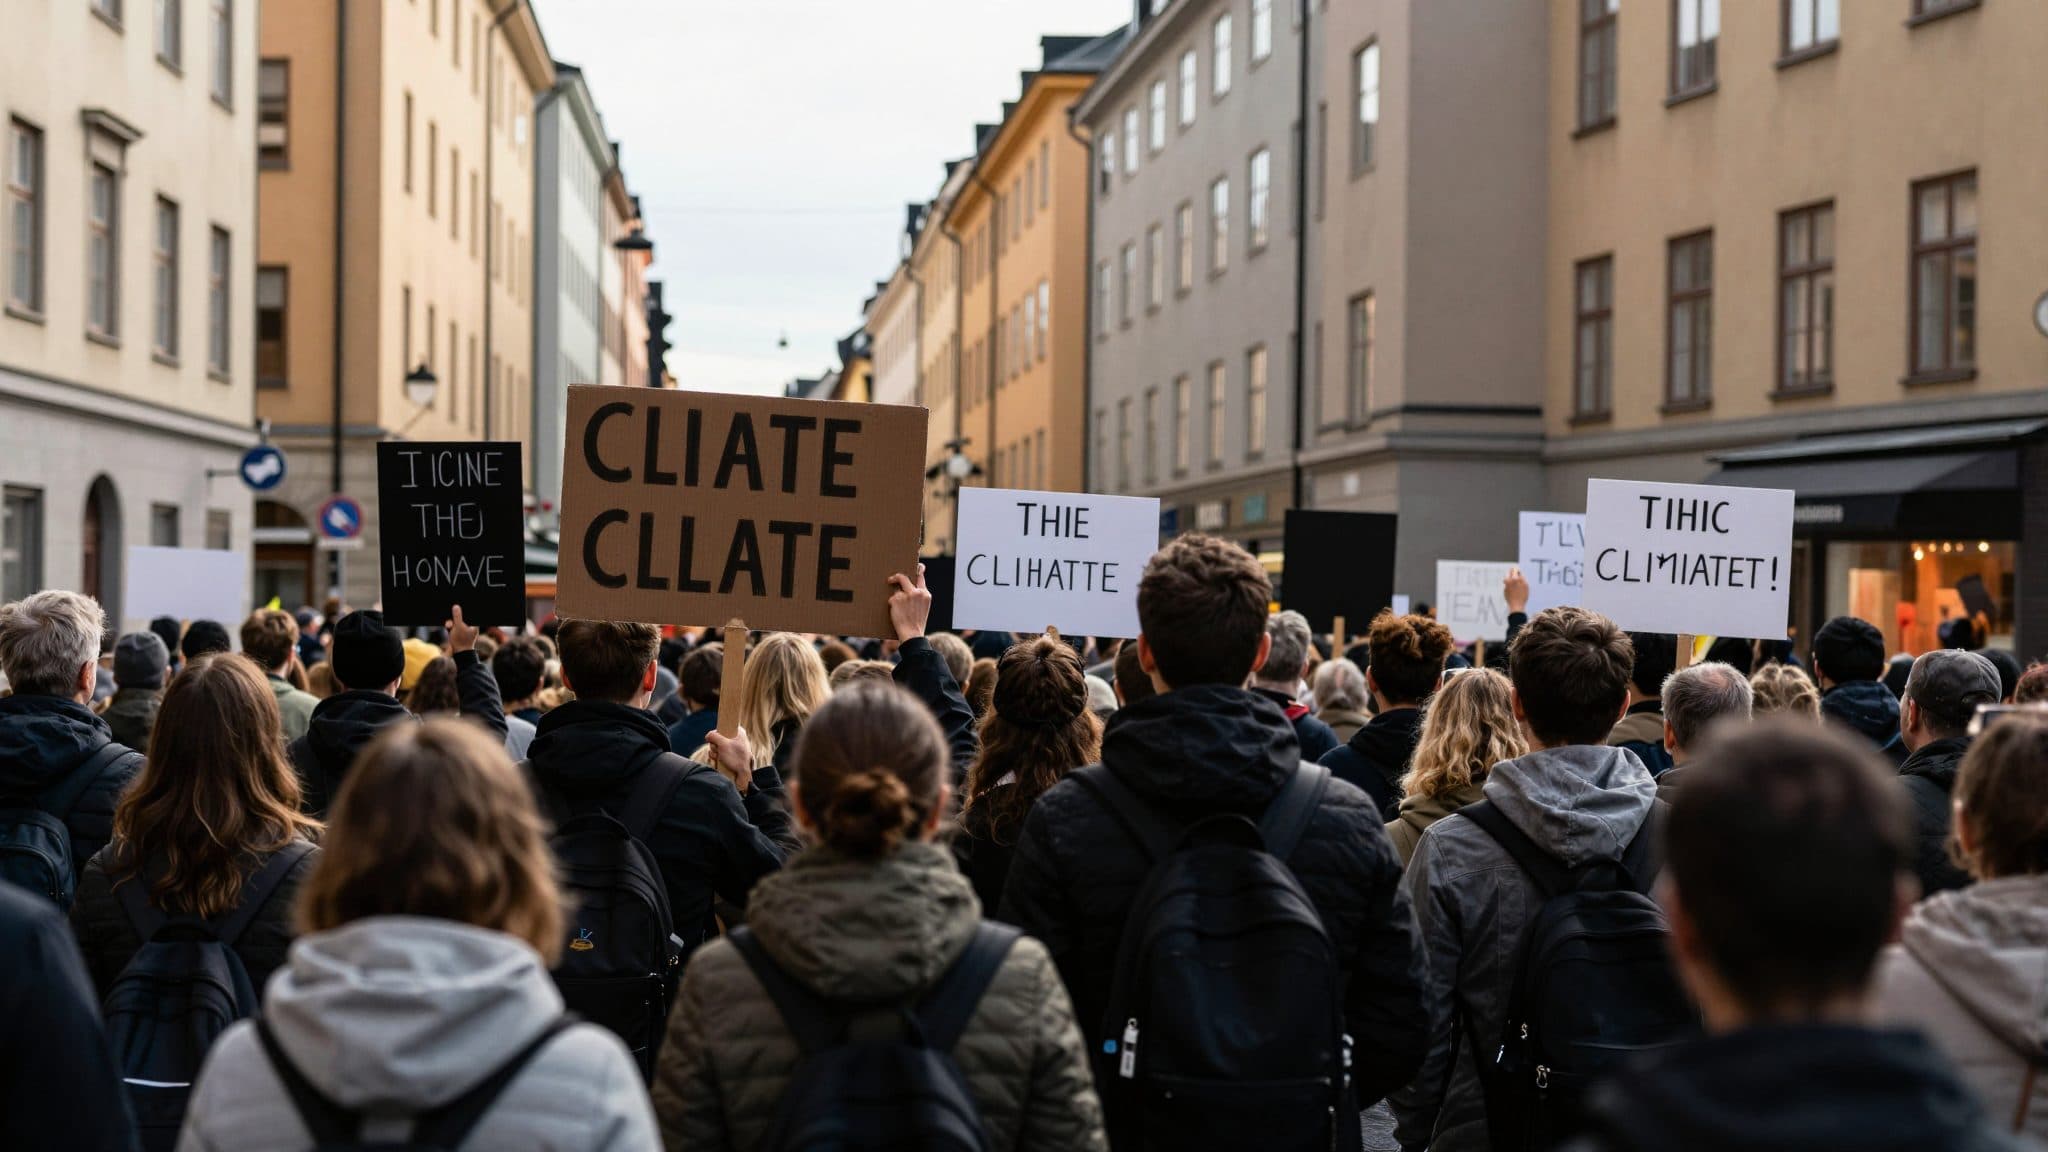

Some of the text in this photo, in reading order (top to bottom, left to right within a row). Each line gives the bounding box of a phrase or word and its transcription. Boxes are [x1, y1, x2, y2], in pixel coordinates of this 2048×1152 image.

[582, 401, 863, 500] CLIATE
[1016, 502, 1090, 539] THIE
[1639, 495, 1730, 533] TIHIC
[391, 555, 507, 588] HONAVE
[581, 507, 859, 604] CLLATE
